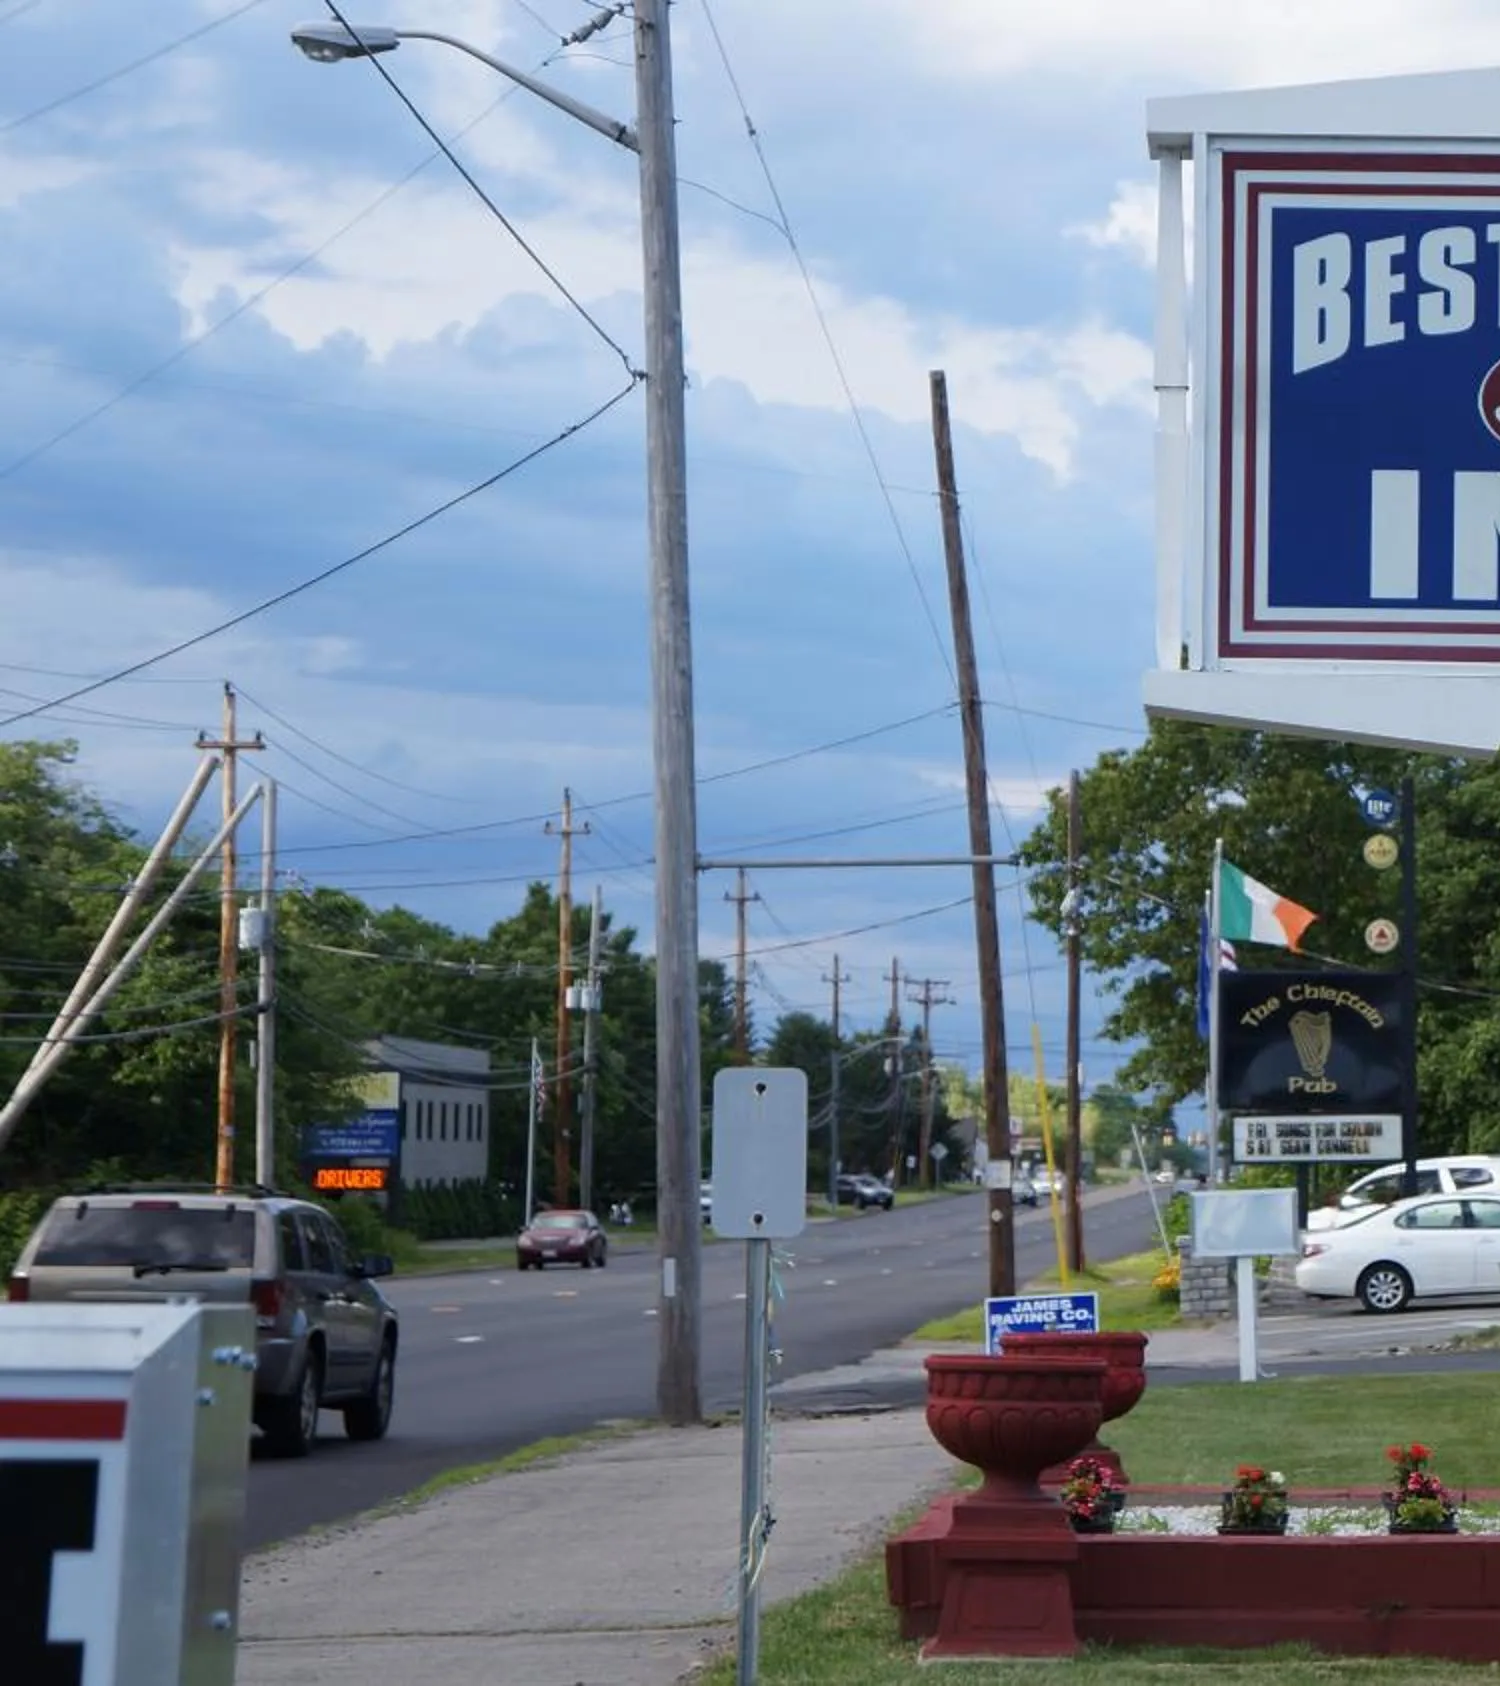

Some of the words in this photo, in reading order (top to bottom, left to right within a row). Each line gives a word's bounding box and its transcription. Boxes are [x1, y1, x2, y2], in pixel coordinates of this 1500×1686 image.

[1239, 996, 1281, 1028] The
[1286, 984, 1385, 1029] Chieftain
[1287, 1076, 1337, 1094] Pub
[317, 1169, 383, 1189] DRIVERS
[1011, 1299, 1073, 1313] JAMES
[991, 1311, 1057, 1325] PAVING
[1061, 1309, 1094, 1322] CO.
